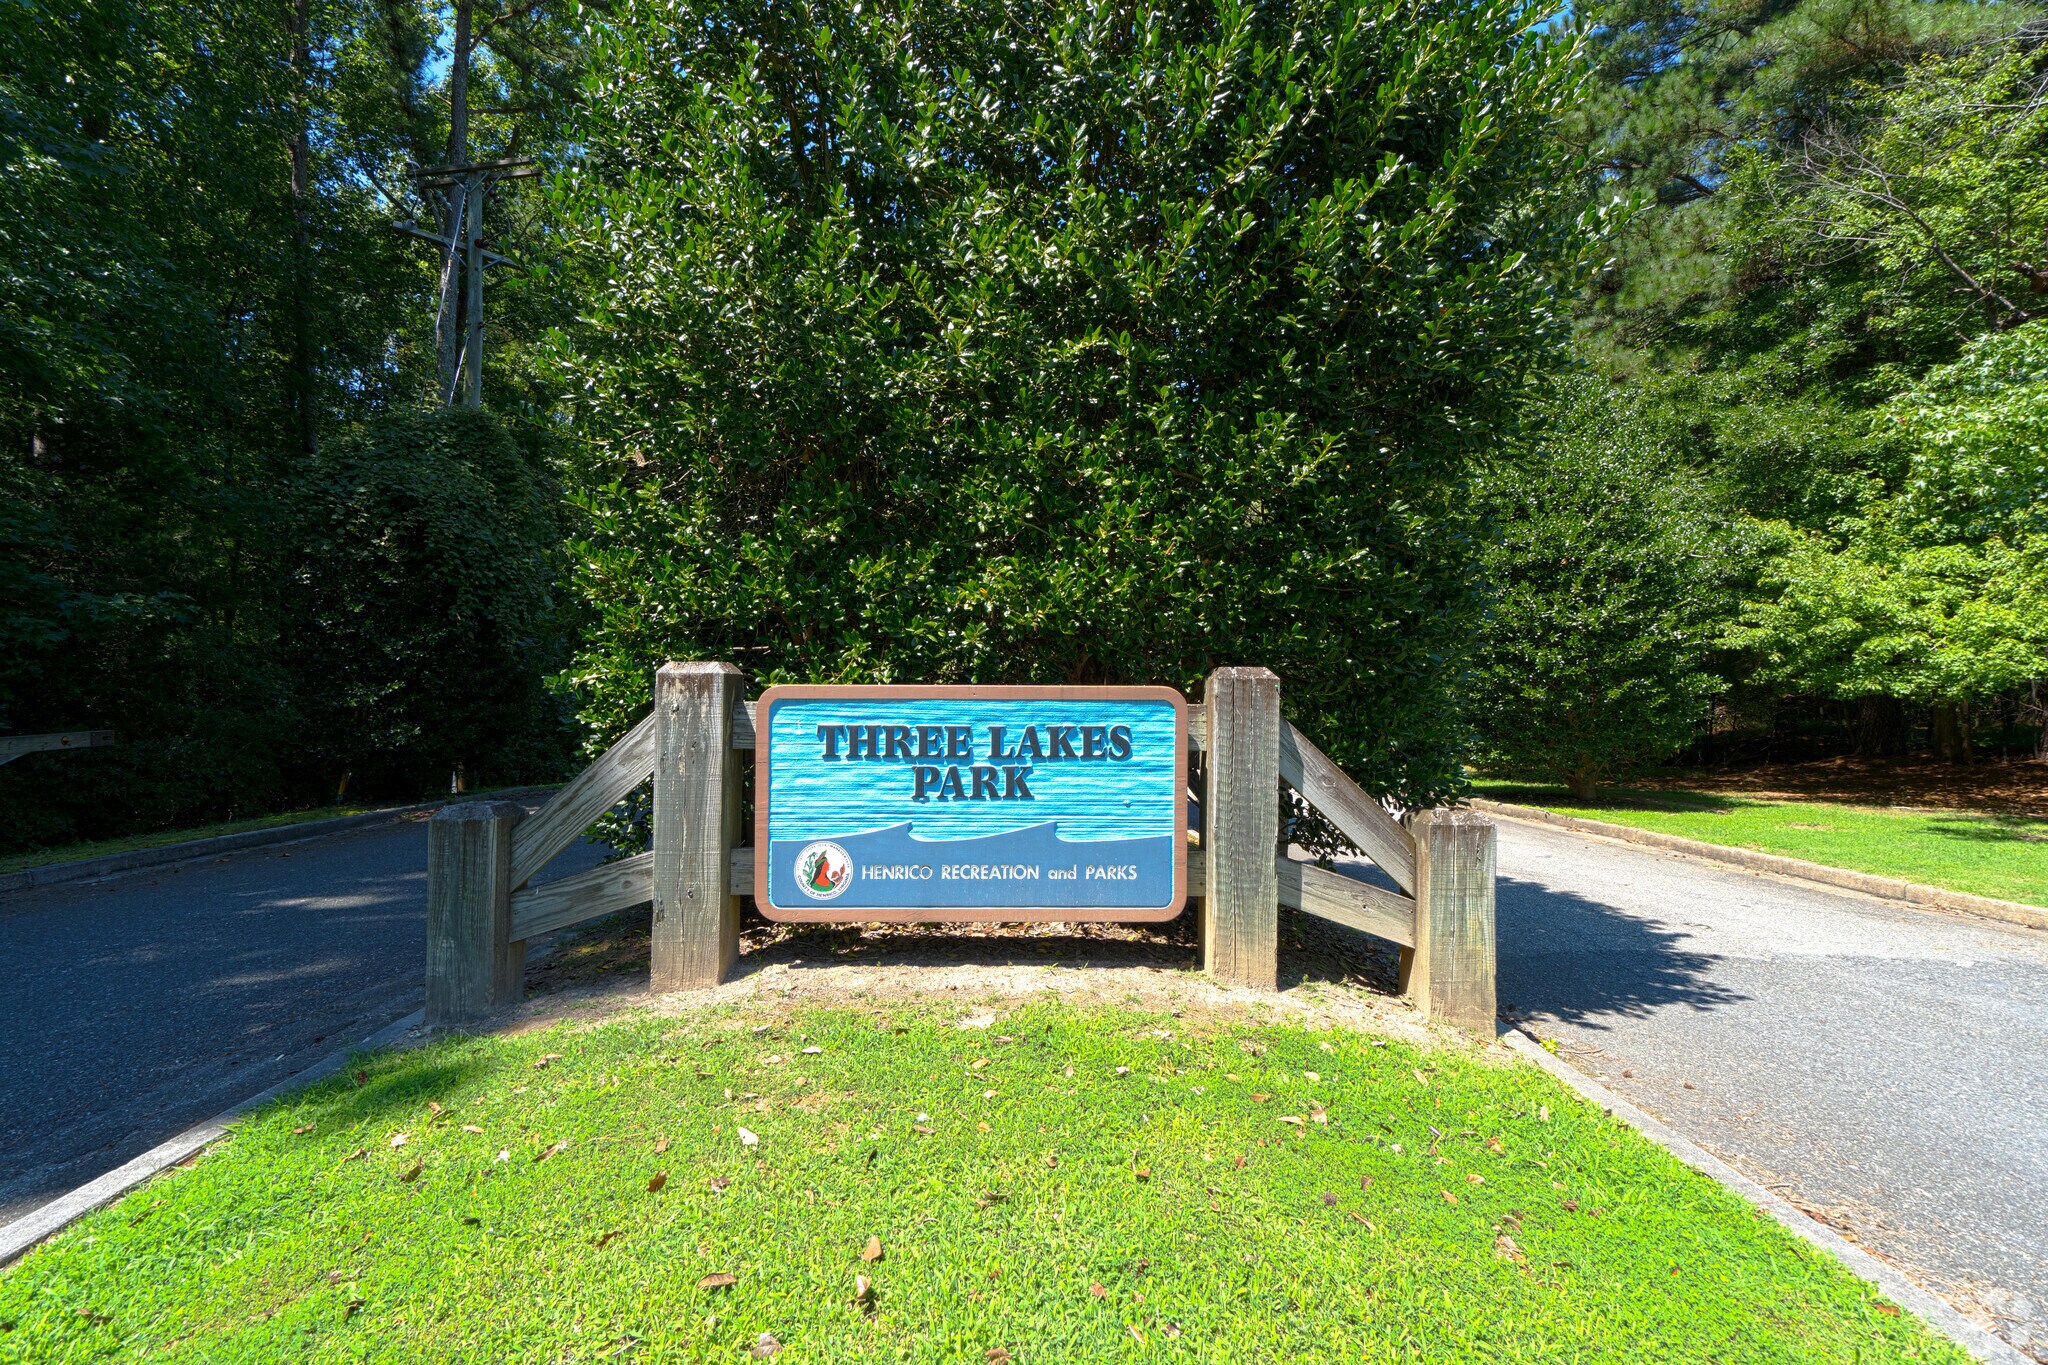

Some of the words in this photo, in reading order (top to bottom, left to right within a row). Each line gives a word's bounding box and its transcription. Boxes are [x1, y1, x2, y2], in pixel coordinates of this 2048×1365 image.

[816, 724, 973, 760] THREE
[987, 724, 1133, 760] LAKES
[911, 765, 1035, 801] PARK
[861, 864, 933, 880] HENRICO
[941, 864, 1040, 880] RECREATION
[1047, 864, 1077, 880] and
[1085, 864, 1138, 880] PARKS
